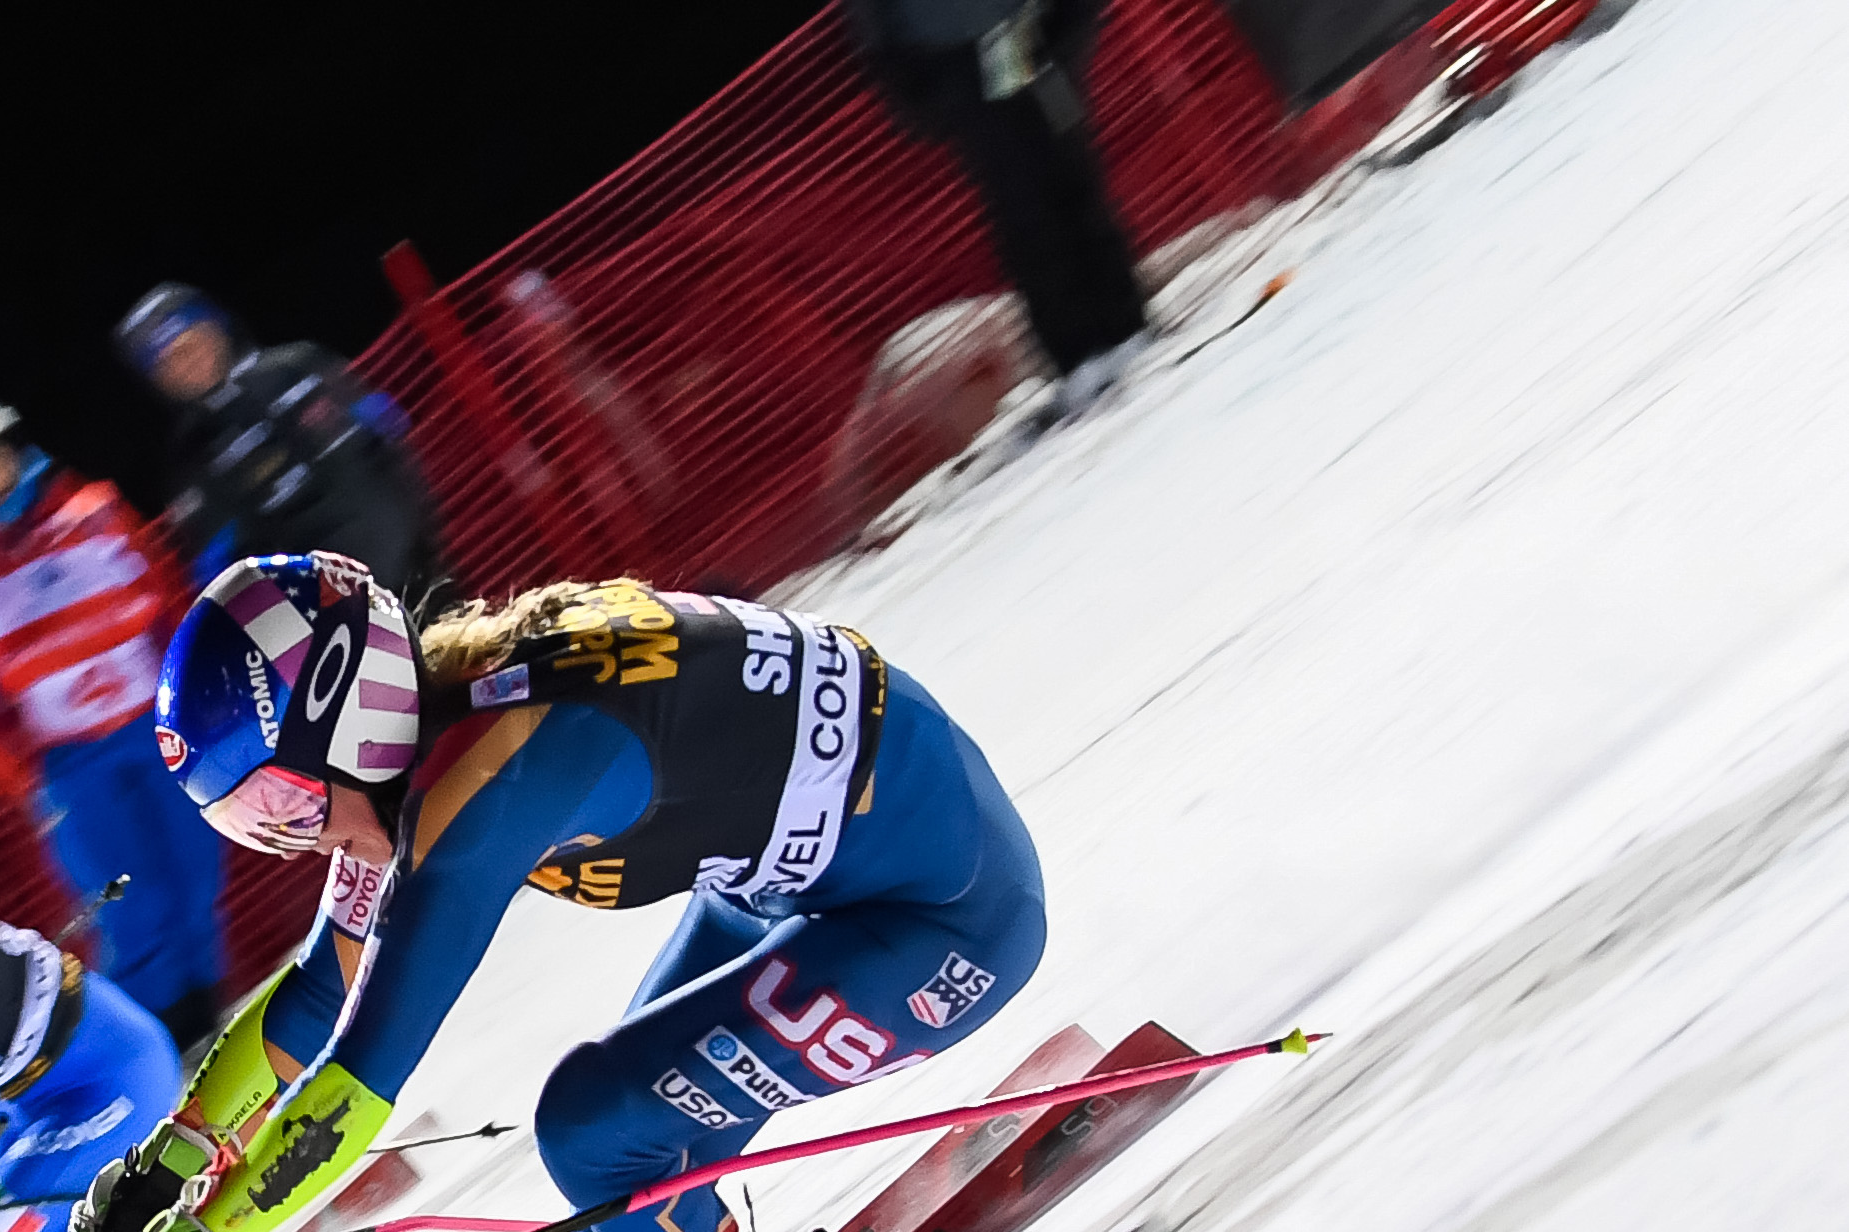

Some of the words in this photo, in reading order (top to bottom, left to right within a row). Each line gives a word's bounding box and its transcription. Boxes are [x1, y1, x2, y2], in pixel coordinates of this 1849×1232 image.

[245, 650, 279, 749] ATOMIC
[765, 810, 828, 892] VEL
[347, 866, 383, 927] TOYOT
[945, 956, 990, 996] US
[659, 1072, 728, 1127] USA
